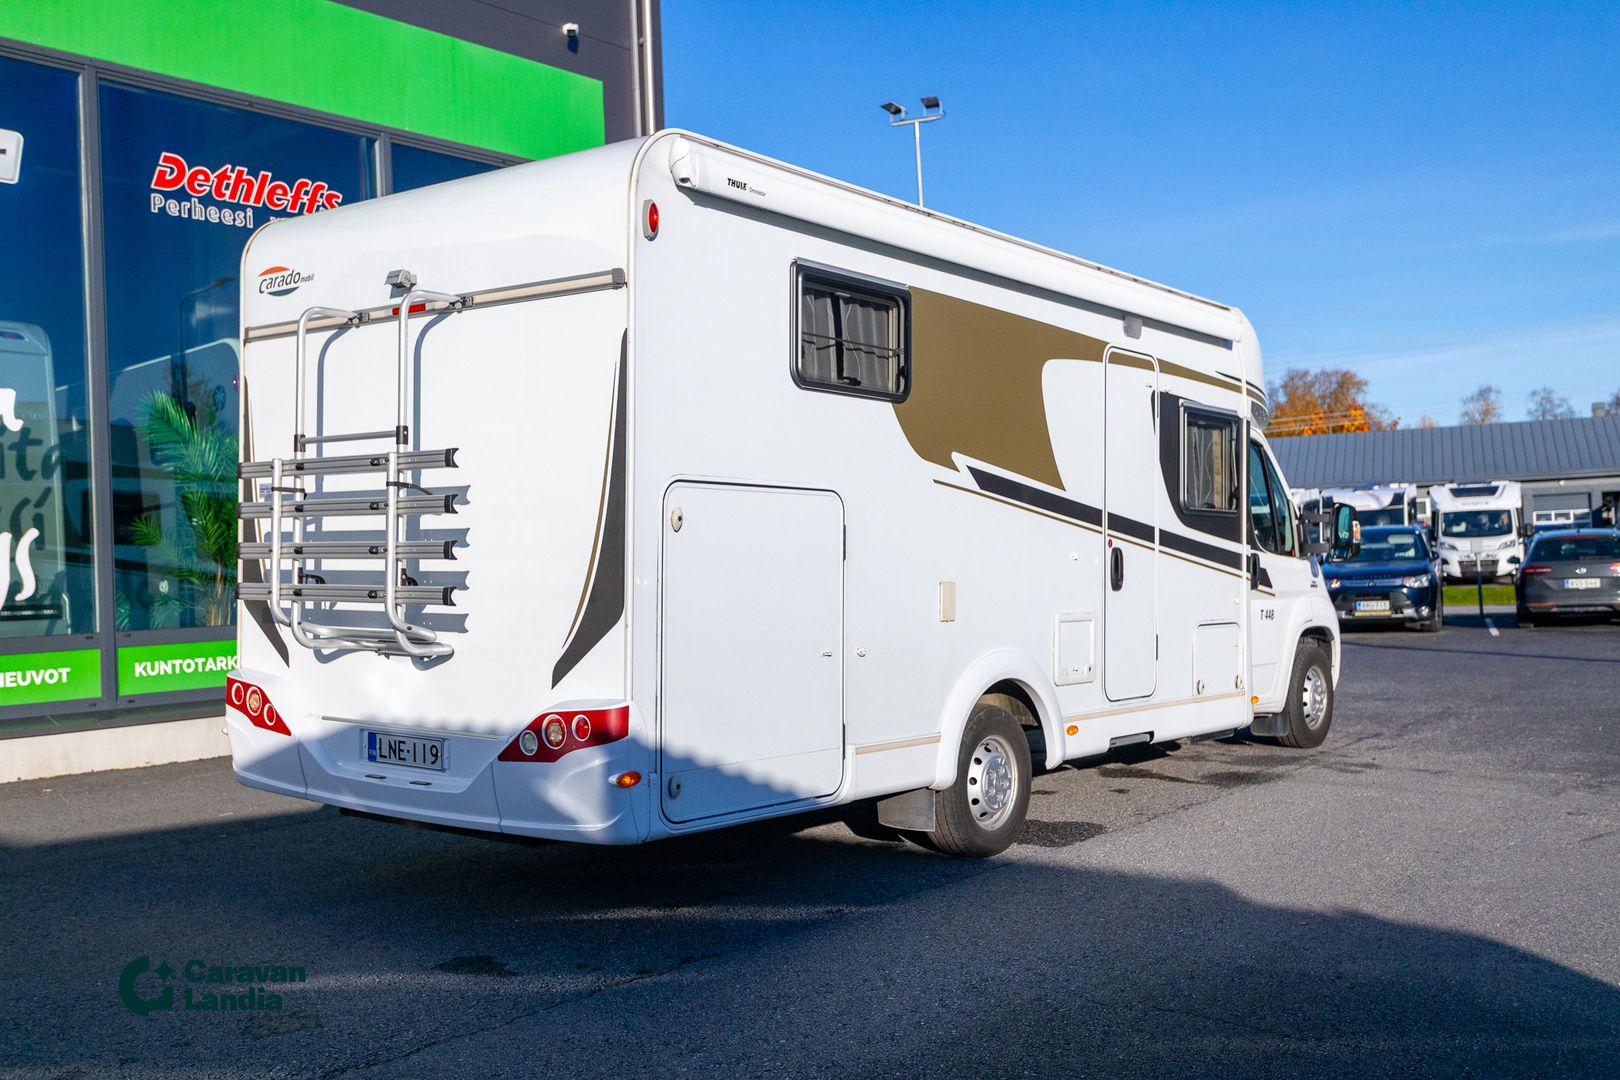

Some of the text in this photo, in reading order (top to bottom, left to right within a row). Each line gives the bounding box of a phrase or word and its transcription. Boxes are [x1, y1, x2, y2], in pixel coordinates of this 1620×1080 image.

[151, 151, 343, 215] Dethleffs
[727, 177, 747, 191] THULE
[151, 193, 254, 229] Perheesi
[300, 273, 314, 283] mobil
[1260, 609, 1275, 621] T 448
[134, 655, 237, 678] KUNTOTARK
[379, 737, 439, 765] LNE-119
